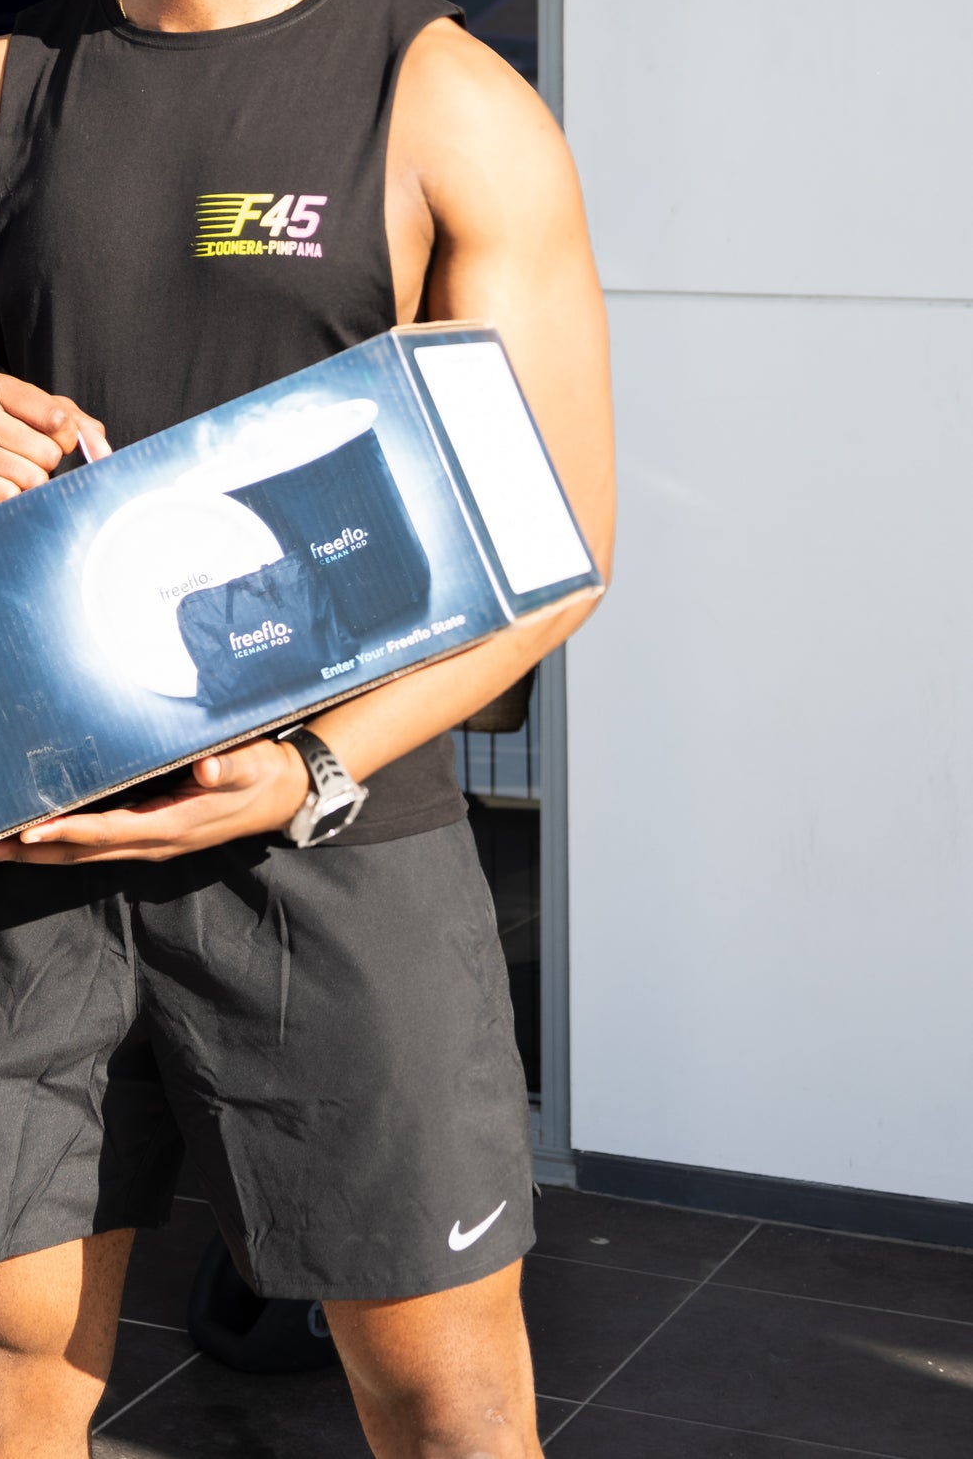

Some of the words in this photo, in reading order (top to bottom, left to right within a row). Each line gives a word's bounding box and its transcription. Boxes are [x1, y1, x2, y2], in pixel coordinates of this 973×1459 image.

[196, 193, 328, 239] F45
[197, 240, 323, 258] COOMERA-PIMPAMA
[350, 539, 368, 552] POD
[234, 643, 268, 659] ICEMAN
[270, 636, 291, 648] POD
[320, 658, 355, 680] Enter
[355, 646, 385, 665] Your
[385, 628, 431, 653] Freeflo
[430, 614, 467, 635] State
